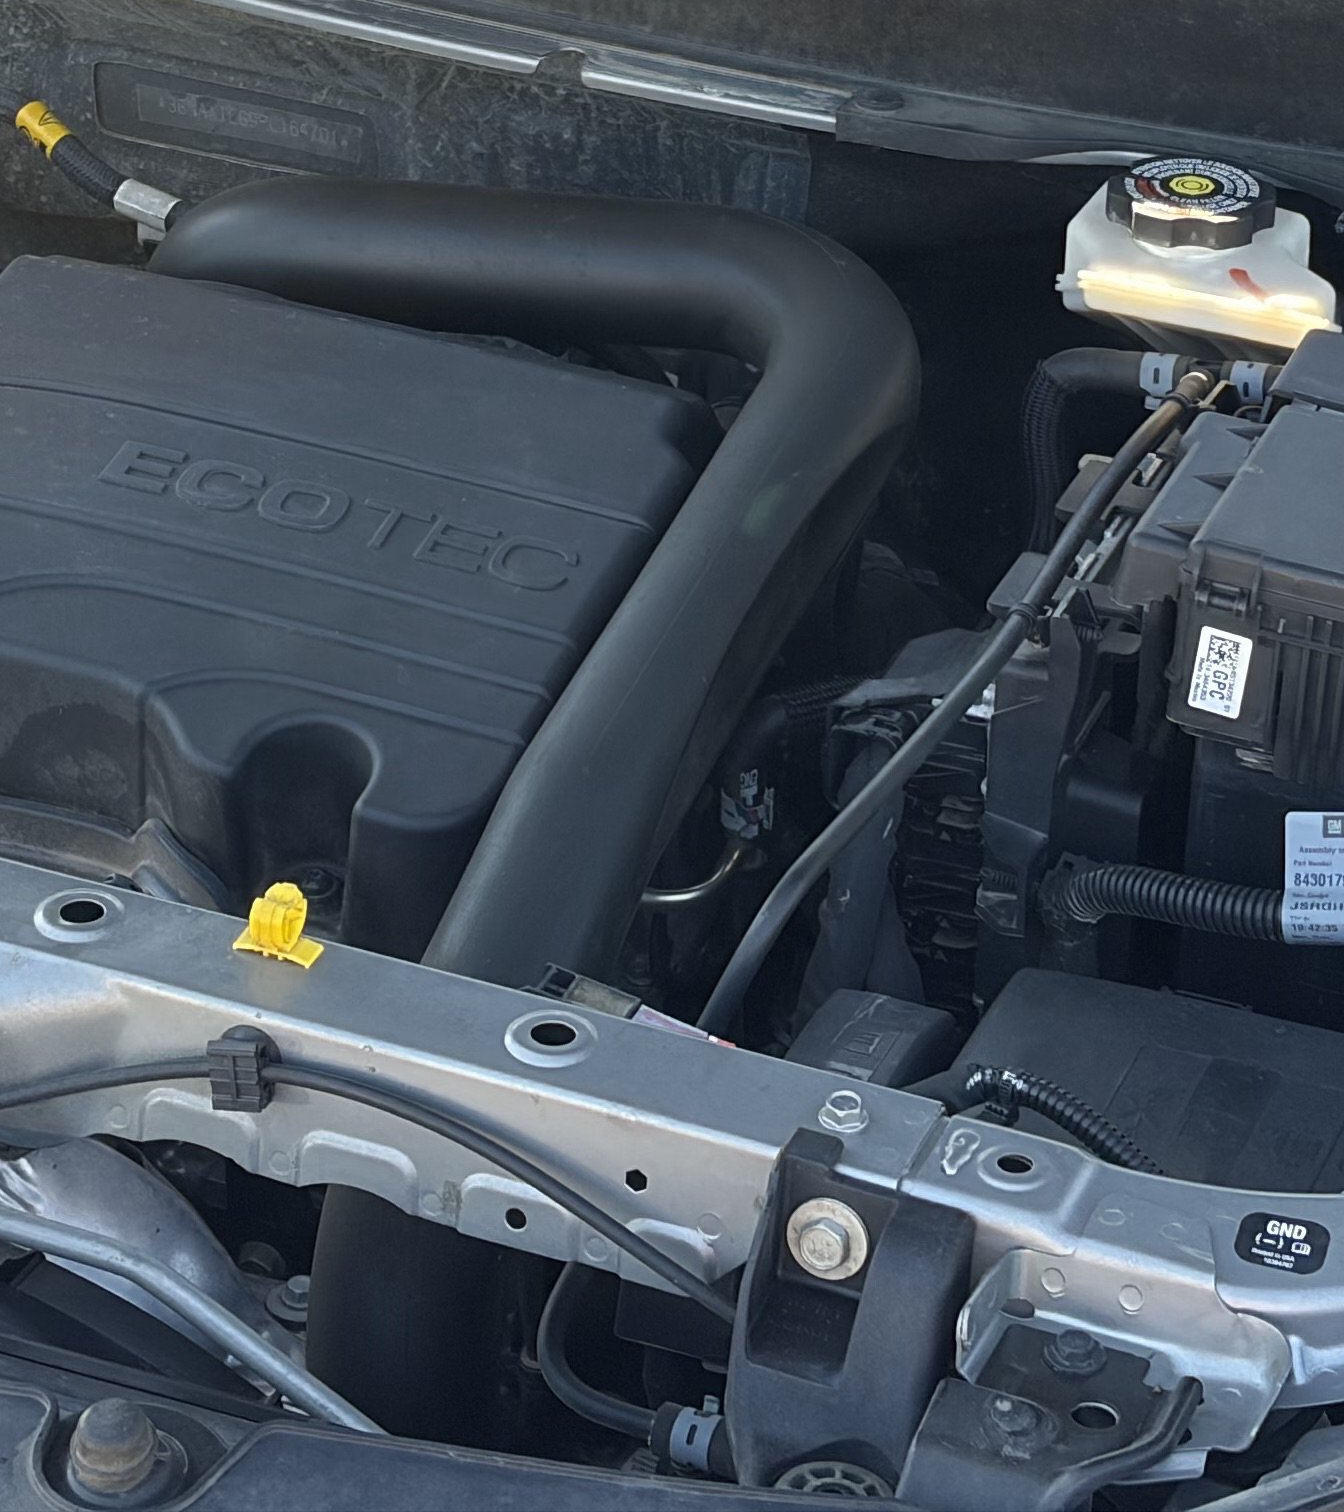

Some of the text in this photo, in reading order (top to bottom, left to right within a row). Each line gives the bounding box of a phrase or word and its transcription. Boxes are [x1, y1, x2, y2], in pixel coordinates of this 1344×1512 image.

[96, 439, 580, 592] ECOTEC
[1209, 670, 1229, 701] GPC
[1266, 1220, 1307, 1240] GND
